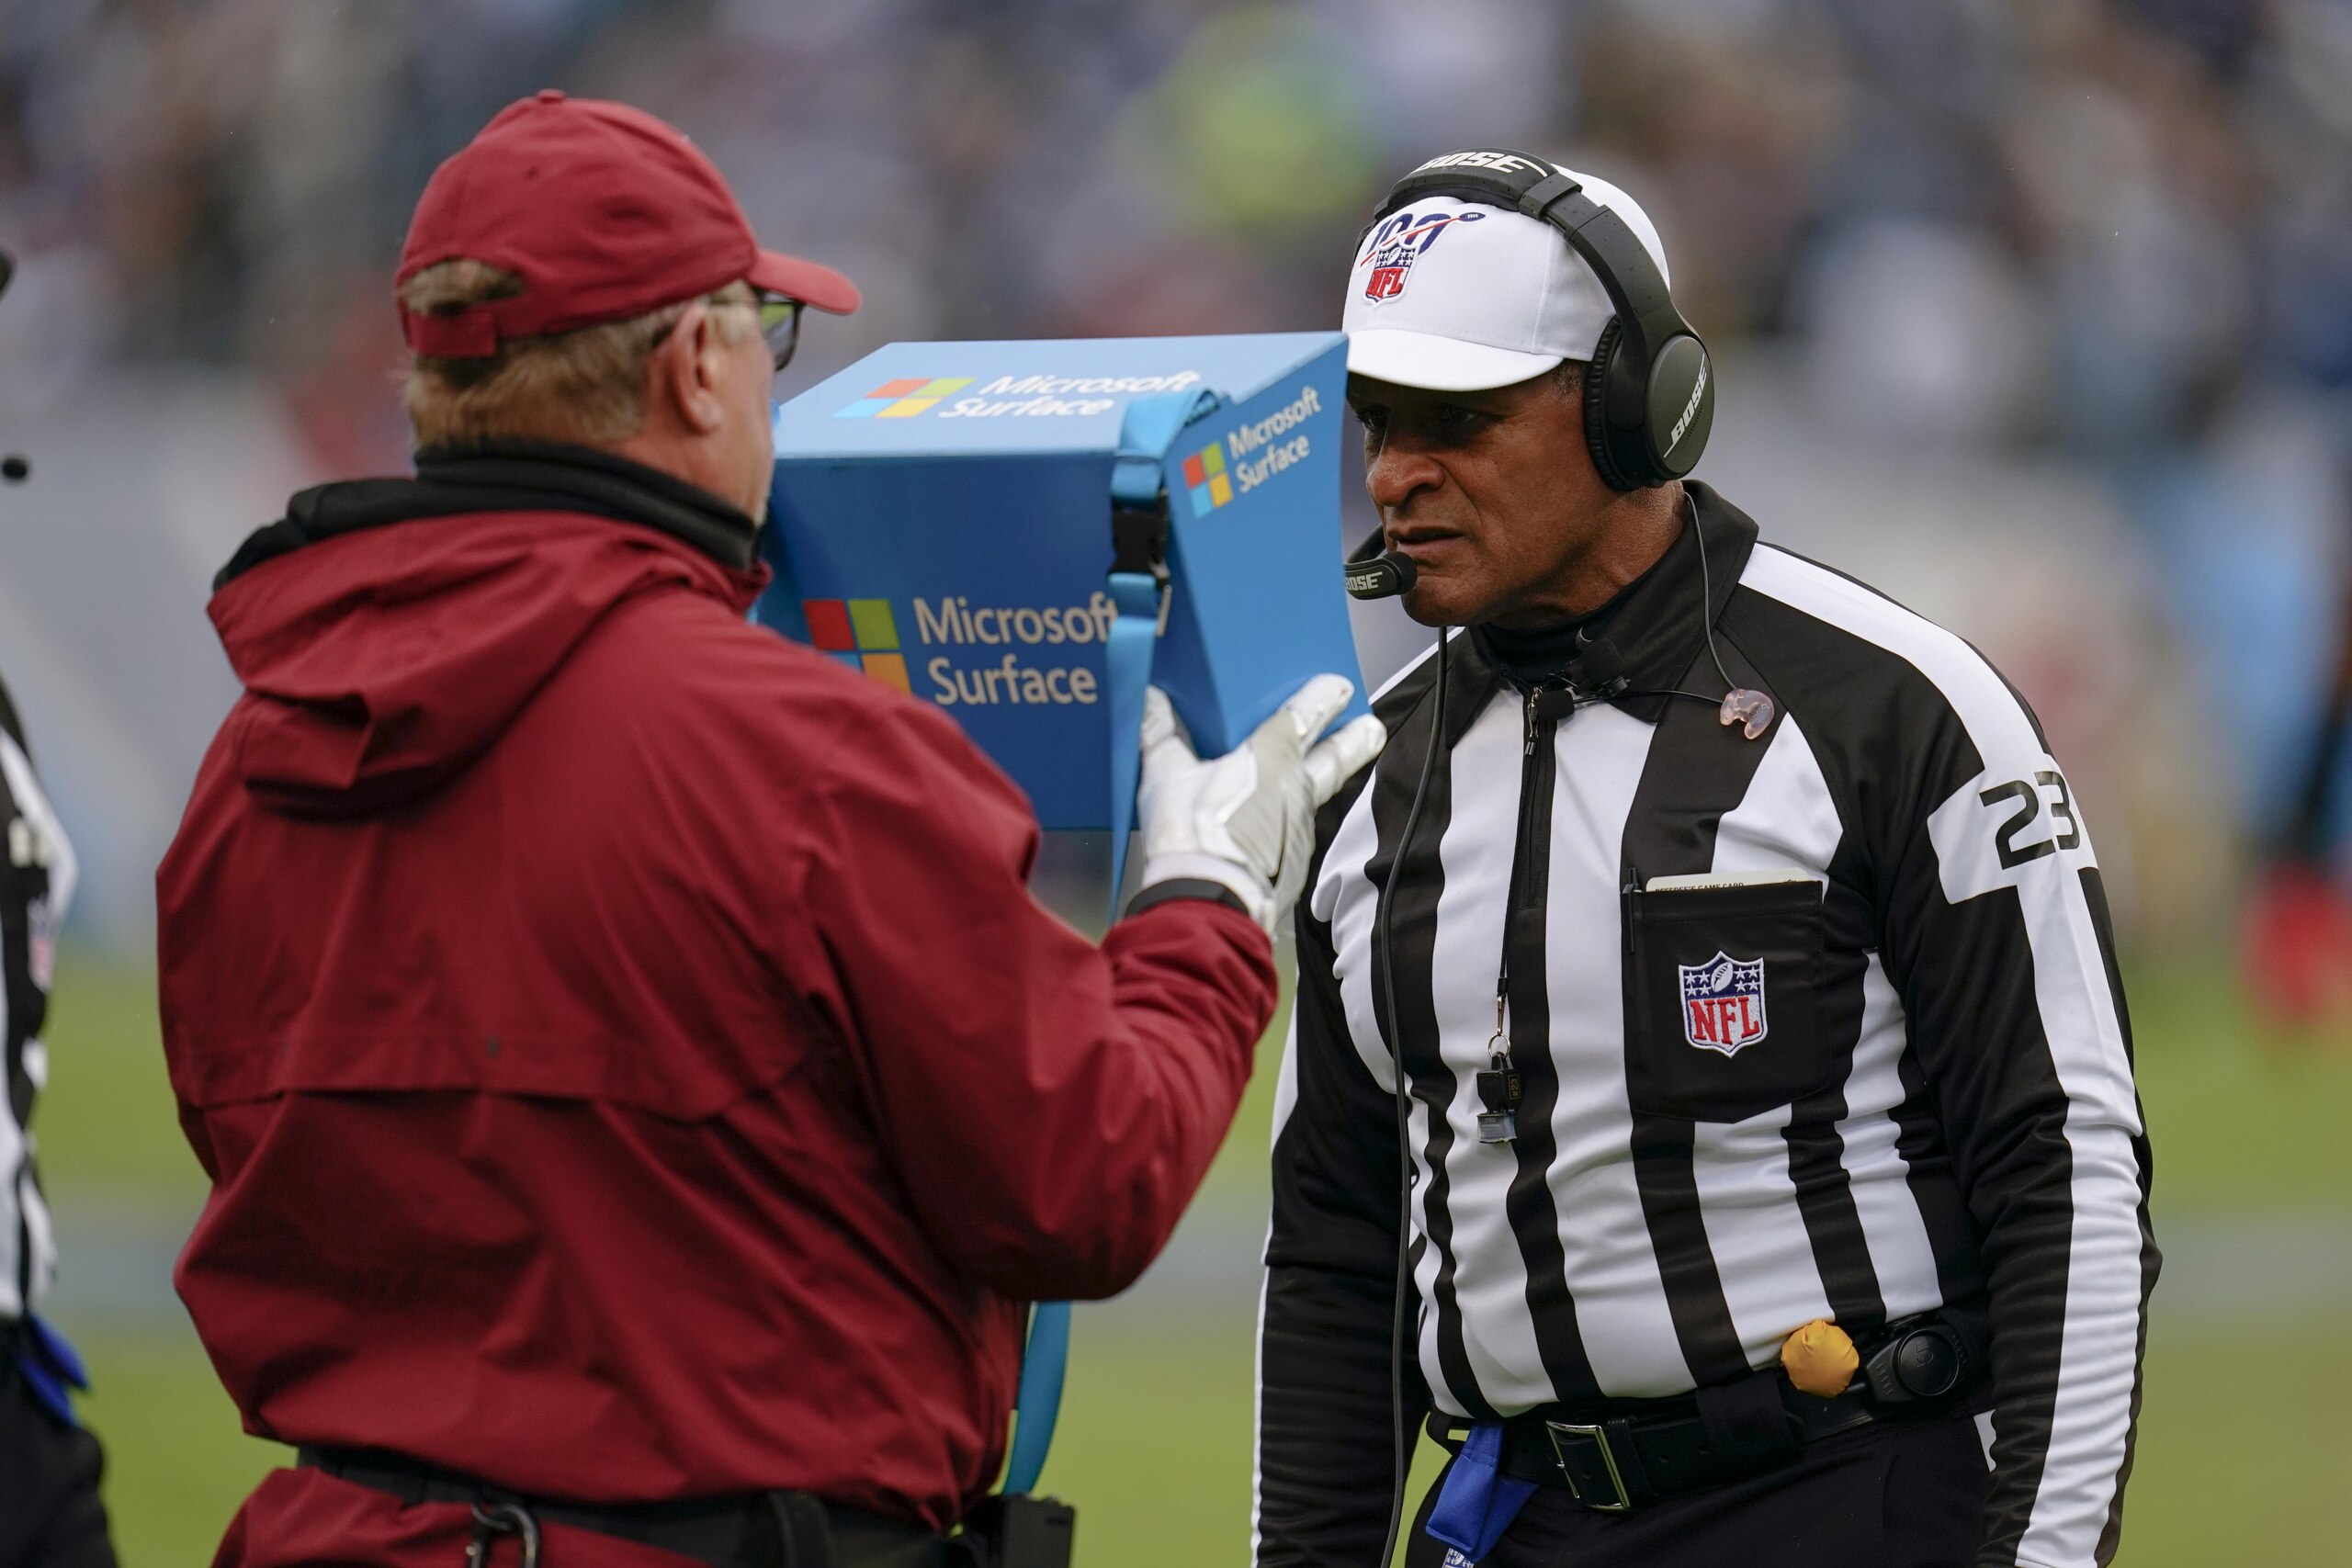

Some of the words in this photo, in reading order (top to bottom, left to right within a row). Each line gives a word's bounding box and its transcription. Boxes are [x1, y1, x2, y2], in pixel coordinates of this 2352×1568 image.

[1403, 152, 1548, 180] BOSE
[1366, 267, 1404, 299] NFL
[938, 397, 1114, 418] Surface
[978, 370, 1200, 395] Microsoft
[1664, 353, 1707, 458] BOSE
[1227, 385, 1322, 460] Microsoft
[1235, 435, 1310, 493] Surface
[913, 591, 1118, 644] Microsoft
[928, 653, 1098, 705] Surface
[1979, 771, 2081, 870] 23
[1690, 997, 1759, 1045] NFL
